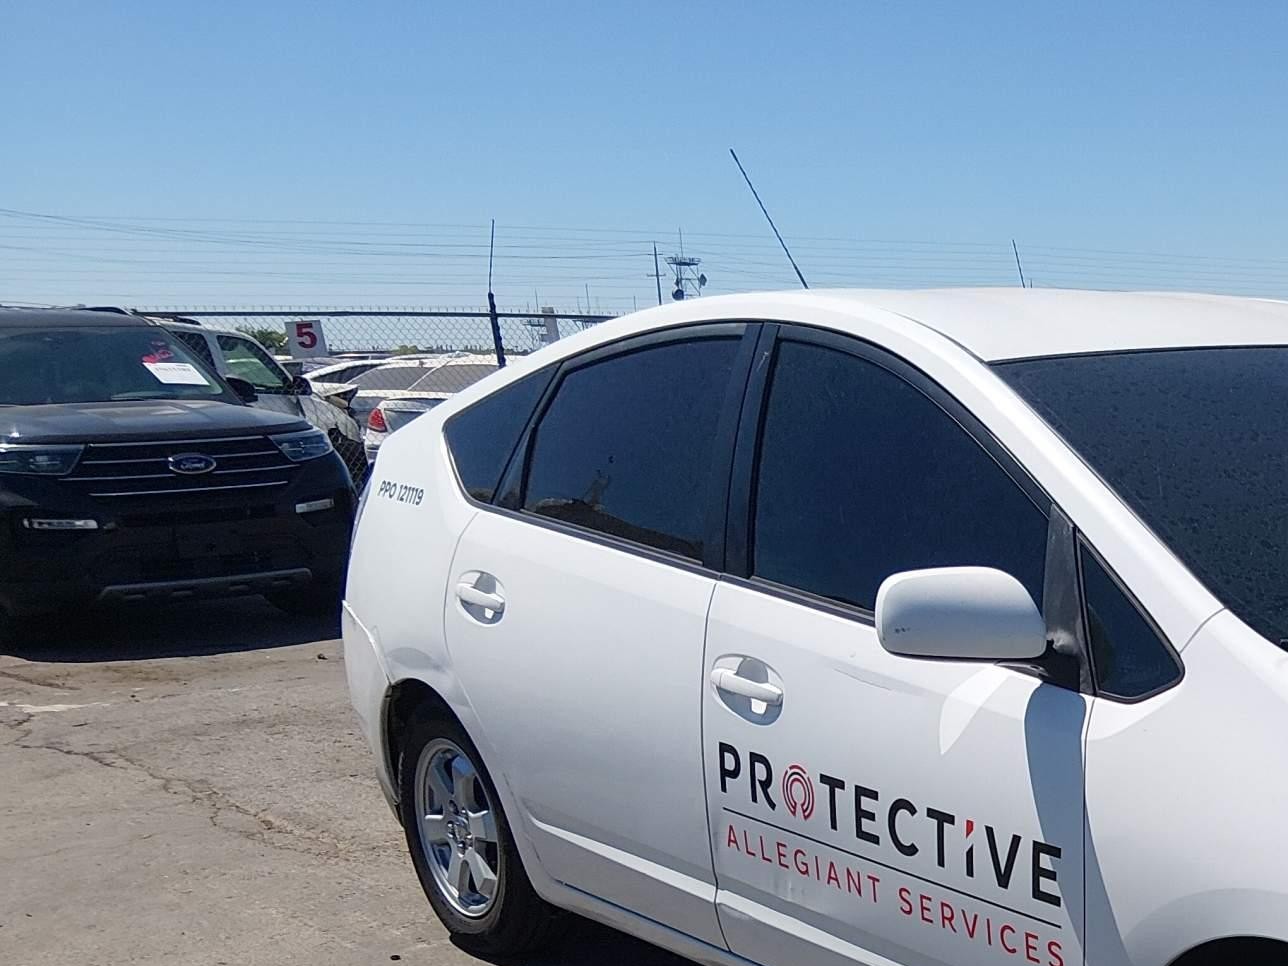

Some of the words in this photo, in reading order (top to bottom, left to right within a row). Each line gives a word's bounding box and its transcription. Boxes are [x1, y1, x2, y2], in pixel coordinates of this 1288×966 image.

[296, 322, 318, 349] 5
[377, 480, 397, 499] PPO
[396, 484, 425, 506] 121119
[718, 741, 1063, 907] PROTECTIVE
[727, 824, 881, 903] ALLEGIANT
